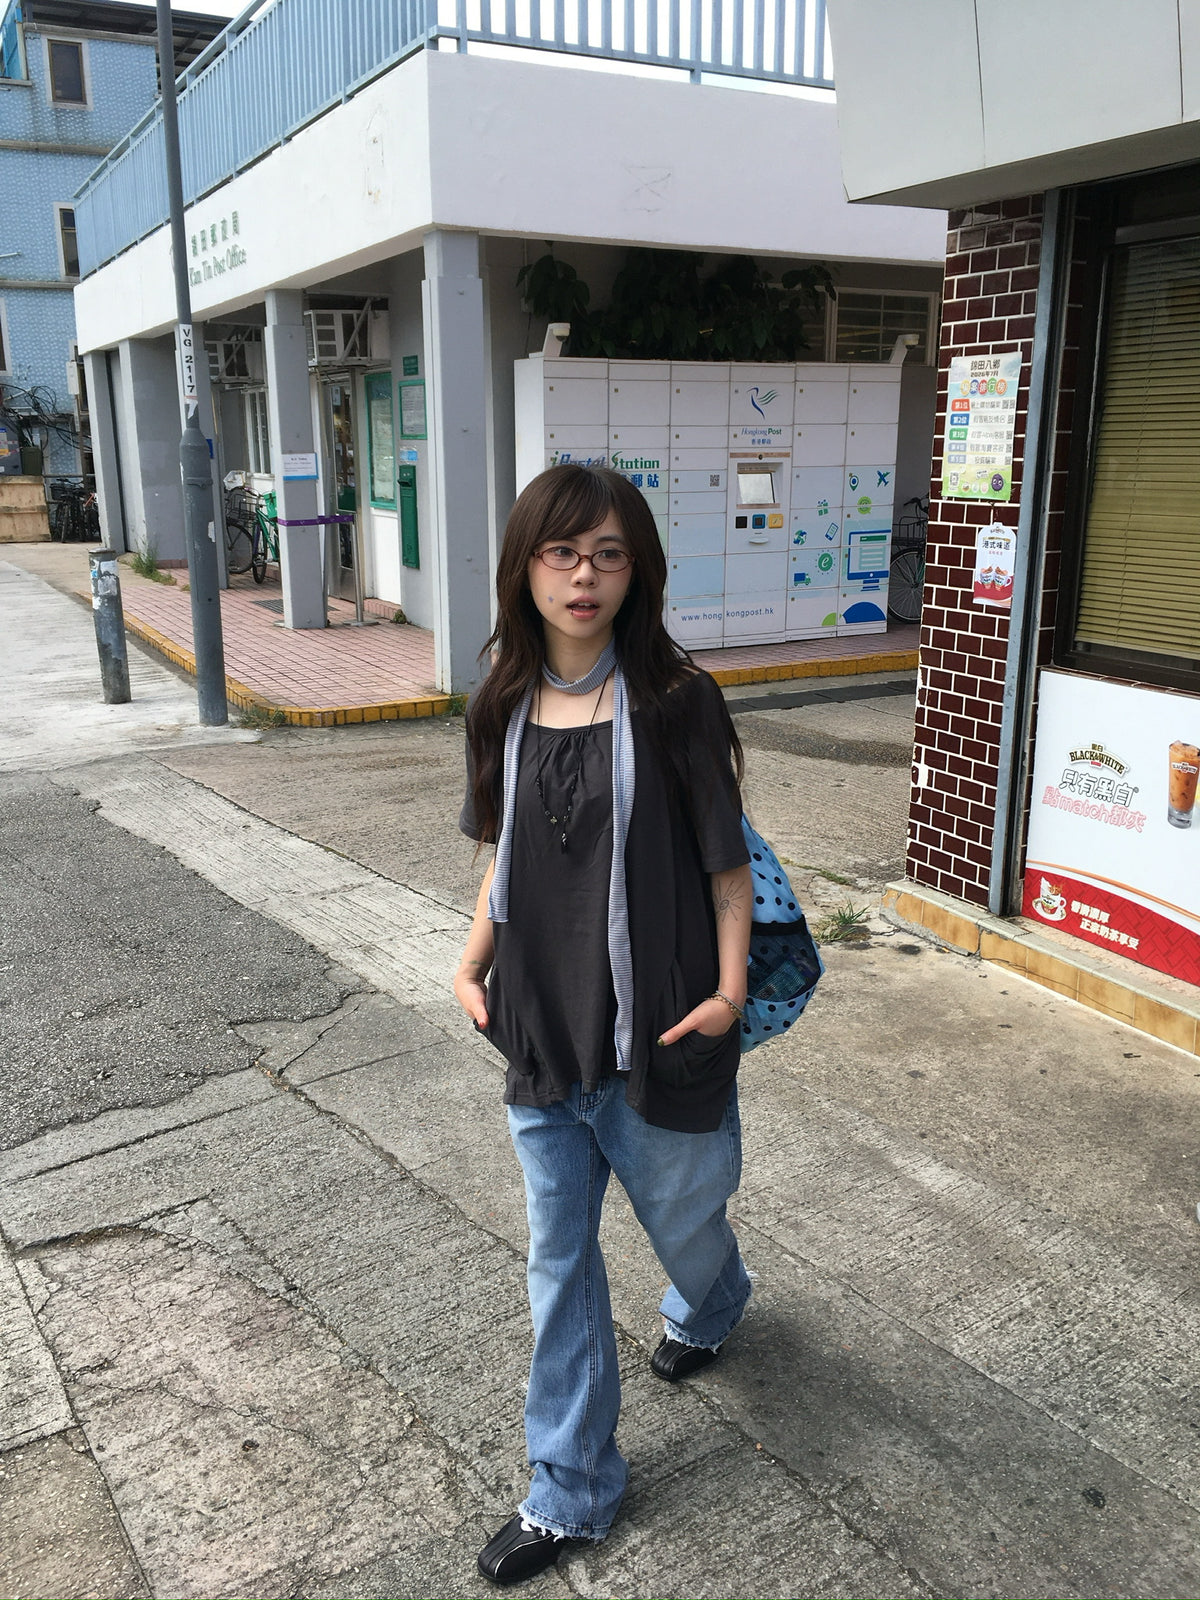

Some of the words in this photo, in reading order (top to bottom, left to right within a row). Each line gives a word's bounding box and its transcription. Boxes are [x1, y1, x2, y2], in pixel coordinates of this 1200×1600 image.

[202, 259, 213, 281] Tin
[213, 255, 226, 276] Post
[226, 243, 247, 270] Office
[183, 328, 192, 347] VG
[185, 355, 195, 393] 2117
[970, 359, 1001, 371] 錦田八鄉
[611, 450, 660, 470] Station
[620, 473, 660, 488] 郵站
[1068, 749, 1126, 775] BLACK&WHITE
